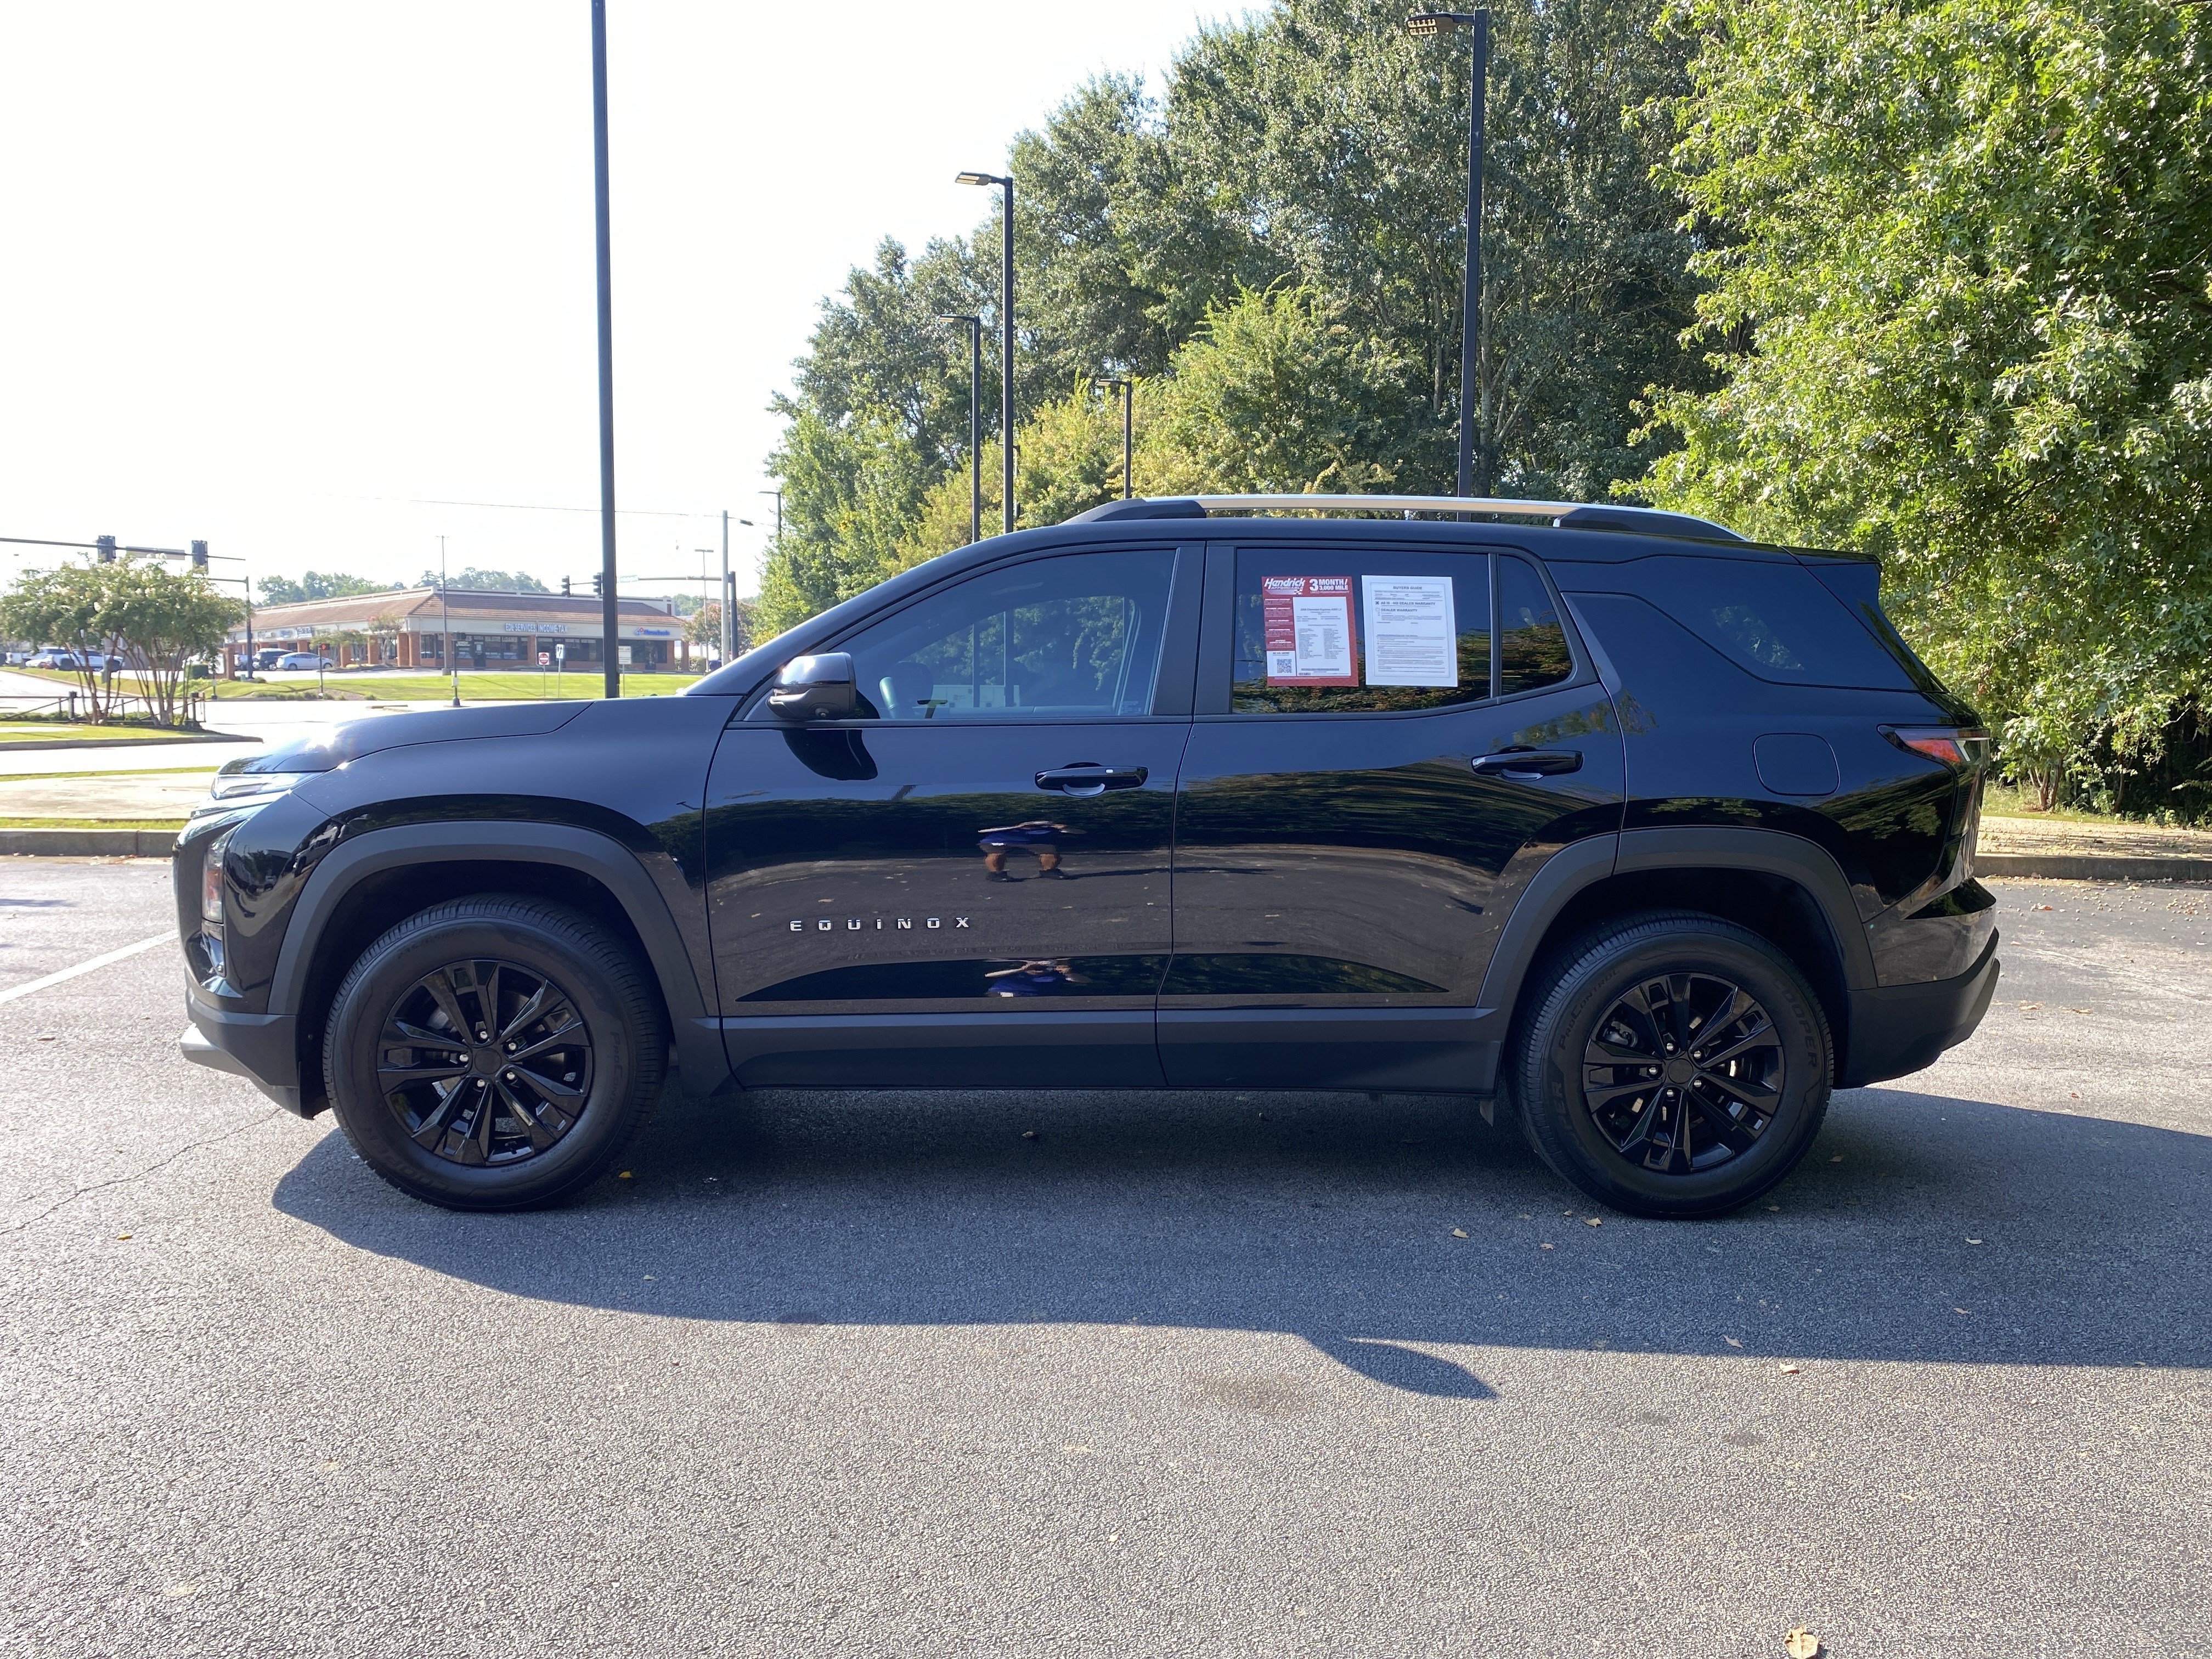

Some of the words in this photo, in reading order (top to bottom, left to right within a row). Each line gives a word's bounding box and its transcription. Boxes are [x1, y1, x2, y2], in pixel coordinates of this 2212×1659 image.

[1264, 578, 1305, 590] Hendrick
[1309, 579, 1318, 591] 3
[515, 623, 535, 632] SERVICES
[790, 917, 969, 931] EQUINOX
